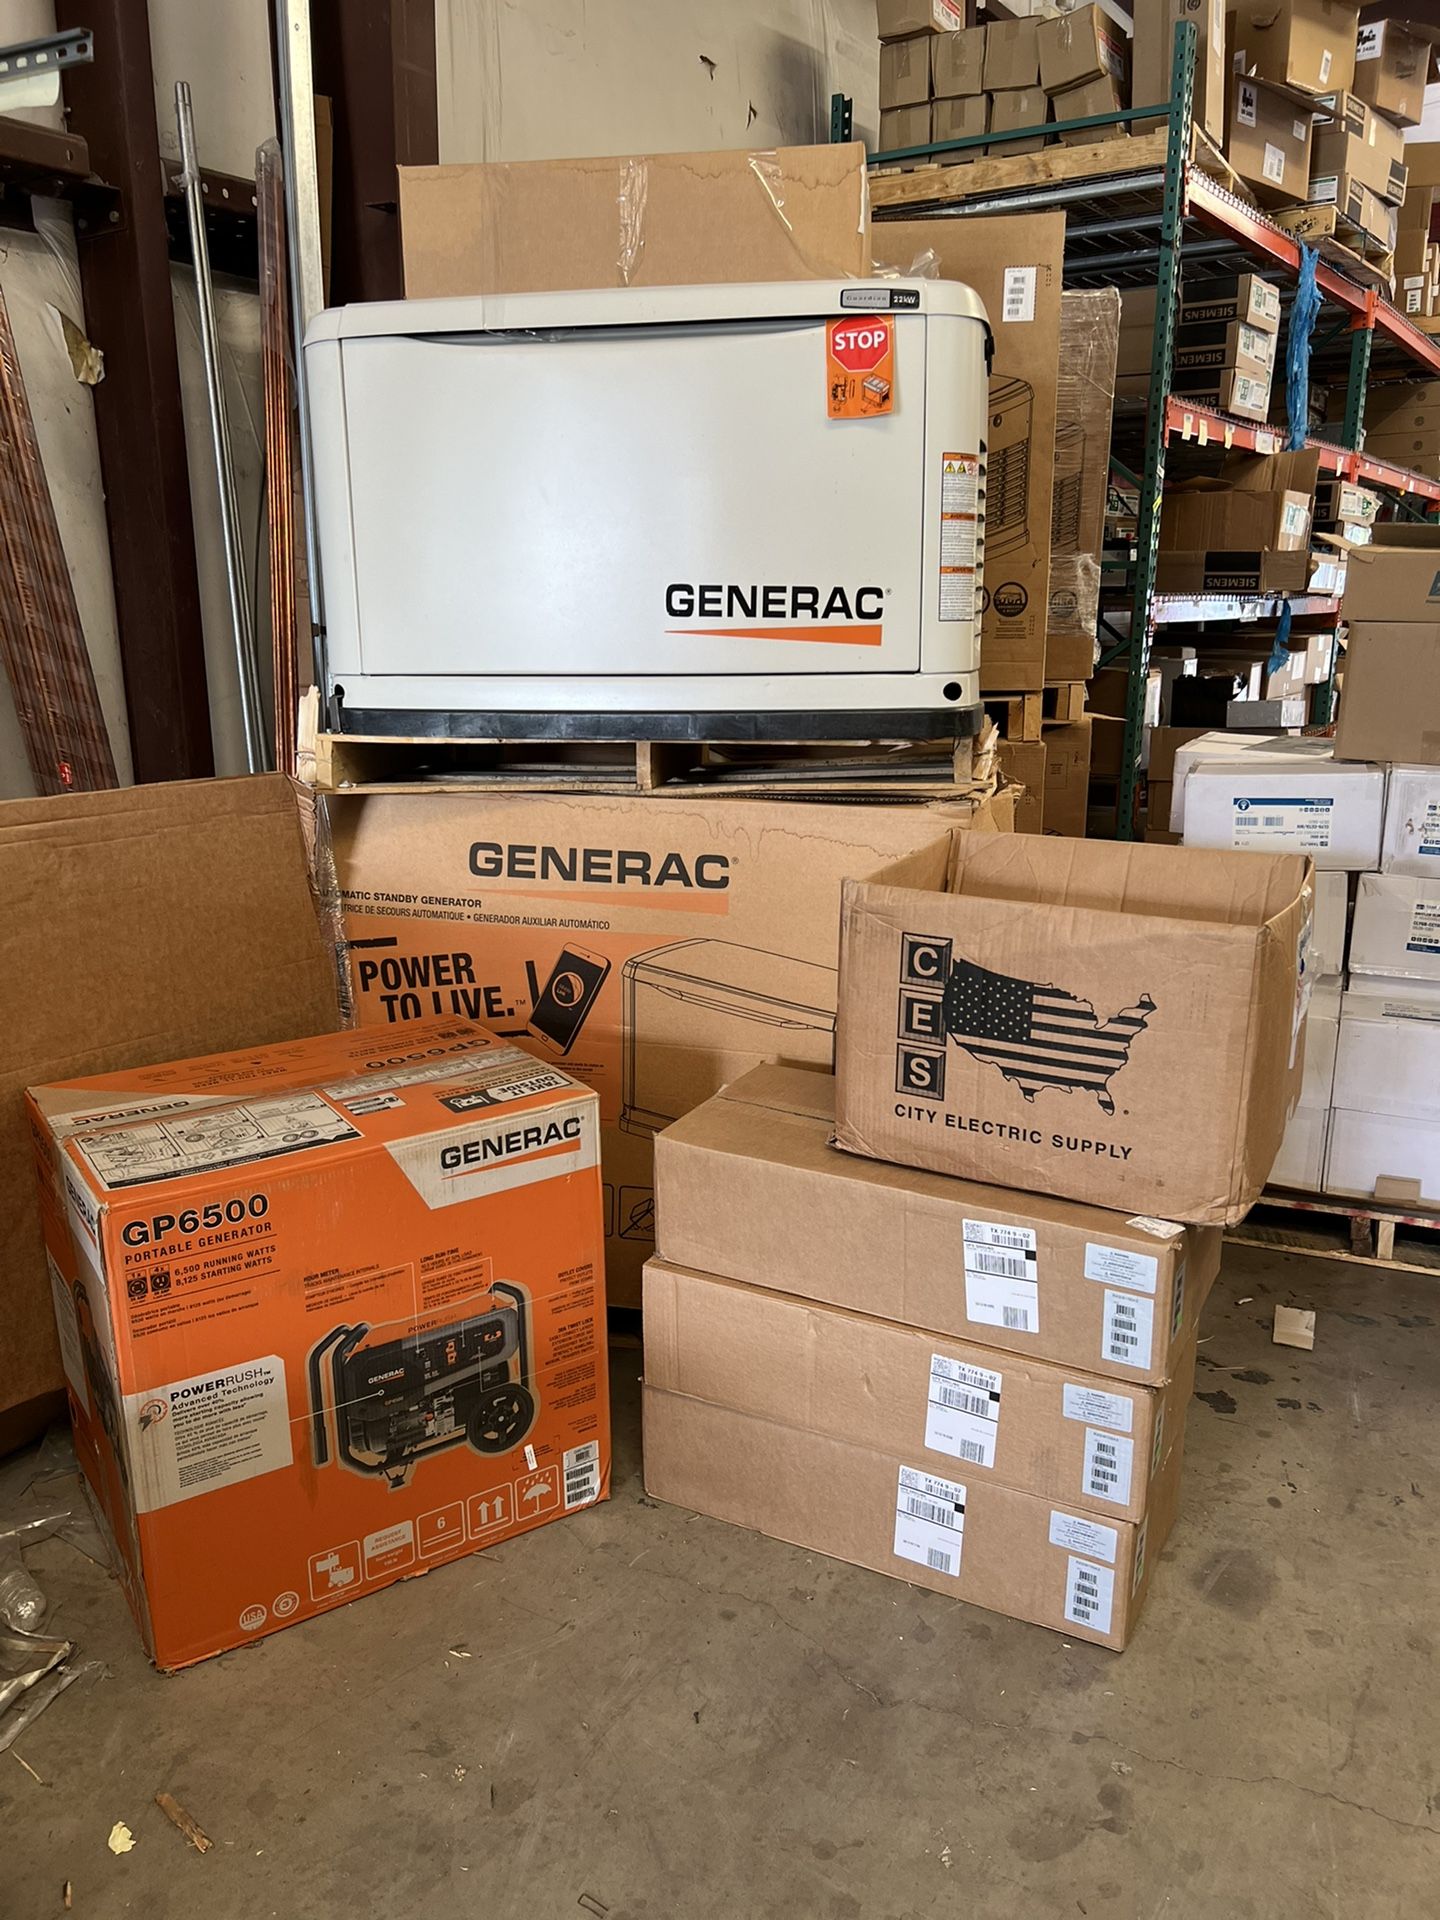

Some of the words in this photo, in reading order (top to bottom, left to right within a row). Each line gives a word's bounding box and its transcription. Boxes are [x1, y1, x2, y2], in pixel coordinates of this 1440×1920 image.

[893, 295, 916, 304] 22kW
[1184, 306, 1235, 320] SIEMENS
[834, 330, 886, 350] STOP
[1205, 577, 1257, 588] SIEMENS
[665, 583, 884, 620] GENERAC
[468, 841, 730, 889] GENERAC
[373, 892, 419, 904] STANDBY
[420, 895, 482, 908] GENERATOR
[365, 905, 376, 914] DE
[376, 905, 411, 917] SECOURS
[412, 908, 465, 921] AUTOMATIQUE
[473, 912, 521, 925] GENERADOR
[522, 916, 558, 927] AUXILIAR
[558, 917, 610, 930] AUTOMÁTICO
[358, 952, 476, 992] POWER
[380, 992, 422, 1023] TO
[365, 1038, 491, 1070] GP6500
[501, 1075, 556, 1093] OUTSIDE
[512, 1089, 527, 1097] IT
[527, 1080, 562, 1091] TAKE
[73, 1100, 191, 1127] GENERAC
[894, 1103, 937, 1124] CITY
[945, 1113, 1042, 1145] ELECTRIC
[1051, 1133, 1132, 1160] SUPPLY
[440, 1116, 581, 1170] GENERAC
[122, 1194, 268, 1246] GP6500
[125, 1240, 192, 1265] PORTABLE
[198, 1221, 272, 1248] GENERATOR
[203, 1253, 243, 1269] RUNNING
[246, 1244, 276, 1258] WATTS
[200, 1264, 241, 1280] STARTING
[244, 1256, 272, 1269] WATTS
[170, 1368, 263, 1402] POWERRUSH
[367, 1367, 405, 1384] GENERAC
[171, 1392, 218, 1411] Advanced
[221, 1376, 275, 1396] Technology
[172, 1406, 196, 1417] Delivers
[189, 1407, 213, 1418] starting
[213, 1399, 239, 1410] capacity
[437, 1516, 446, 1529] 6
[242, 1609, 263, 1624] USA
